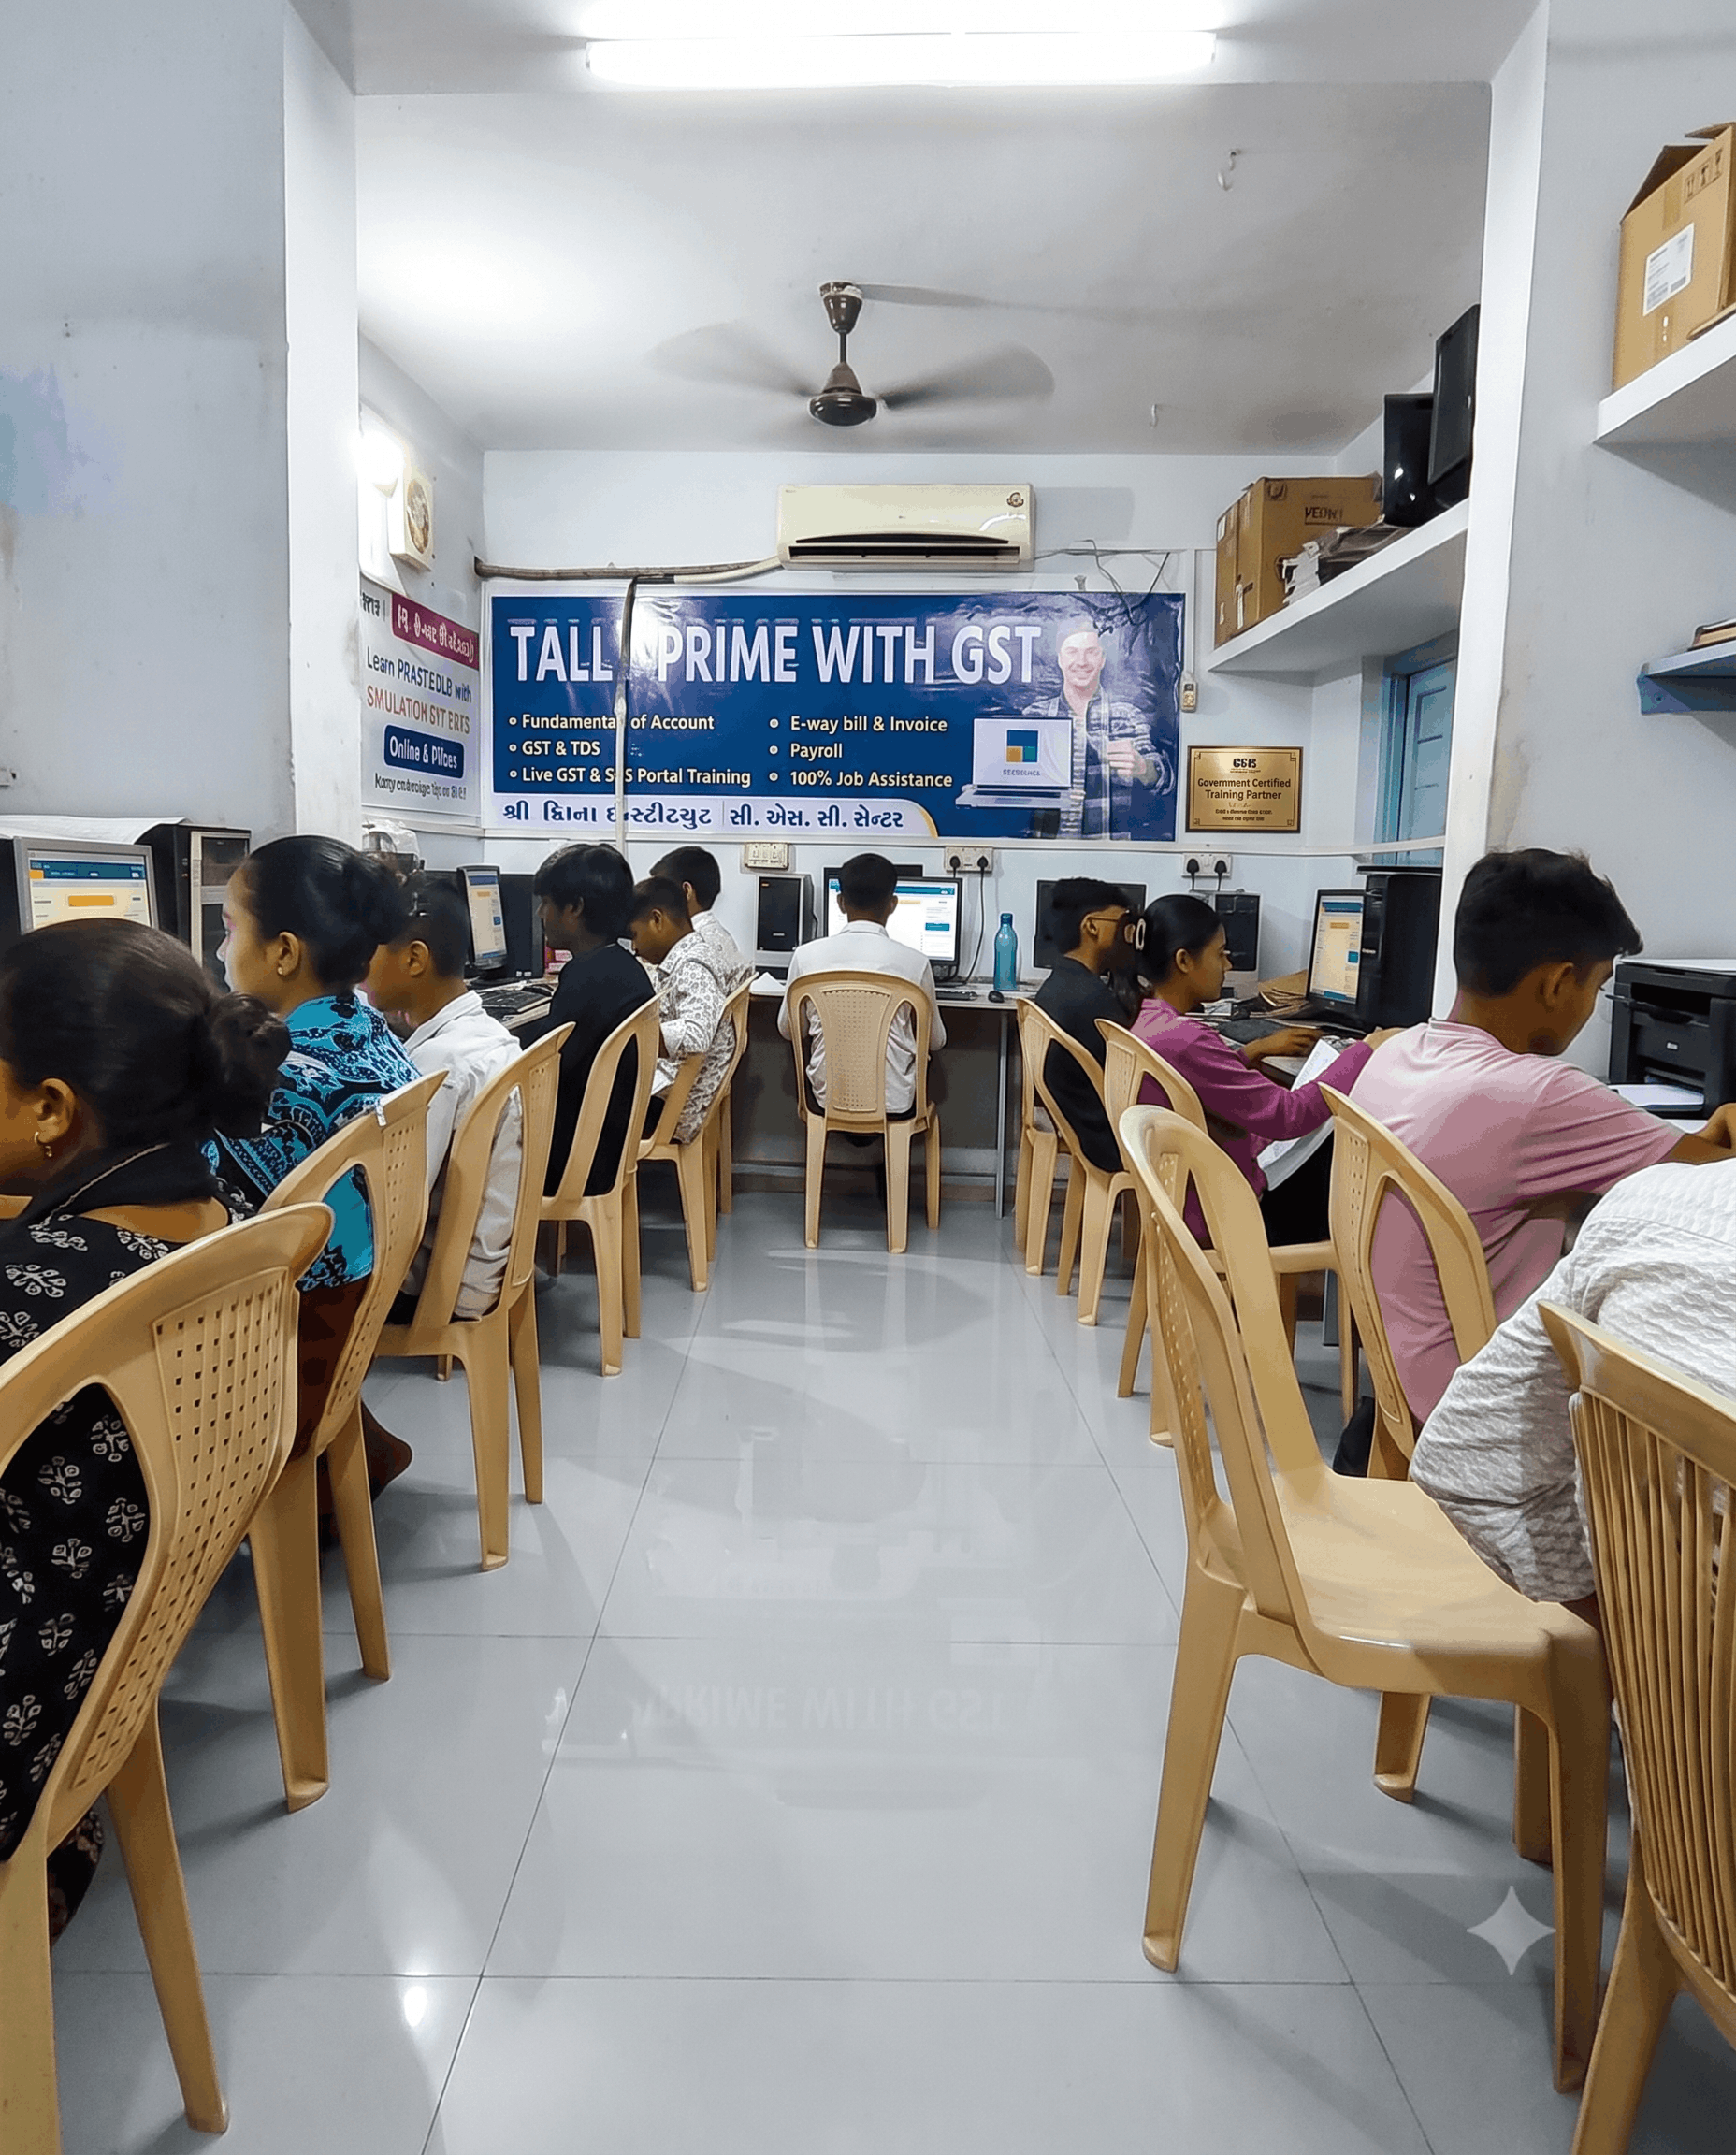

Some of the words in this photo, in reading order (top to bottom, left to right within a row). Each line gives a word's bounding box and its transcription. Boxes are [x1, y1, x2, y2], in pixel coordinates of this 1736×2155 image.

[367, 645, 395, 678] Learn
[510, 626, 614, 682] TALL
[658, 625, 798, 683] PRIME
[812, 625, 935, 683] WITH
[951, 625, 1042, 684] GST
[522, 714, 616, 729] Fundamenta
[630, 714, 647, 730] of
[650, 714, 715, 730] Account
[790, 716, 839, 734] E-way
[843, 716, 868, 731] bill
[873, 716, 886, 731] &
[890, 716, 948, 732] Invoice
[422, 743, 429, 763] &
[522, 741, 552, 755] GST
[556, 741, 568, 755] &
[570, 741, 600, 755] TDS
[790, 743, 843, 761] Payroll
[523, 767, 553, 782] Live
[557, 767, 586, 782] GST
[589, 768, 601, 782] &
[604, 767, 633, 783] SS
[637, 767, 683, 784] Portal
[687, 768, 751, 788] Training
[789, 771, 832, 786] 100%
[836, 771, 864, 787] Job
[867, 772, 953, 787] Assistance
[1197, 778, 1251, 788] Government
[1251, 777, 1292, 788] Certified
[1205, 789, 1244, 802] Training
[1246, 789, 1282, 800] Partner
[502, 800, 529, 821] શ્રી
[730, 803, 760, 826] સી.
[766, 803, 811, 827] એસ.
[817, 804, 847, 828] સી.
[854, 803, 904, 828] સેન્ટર
